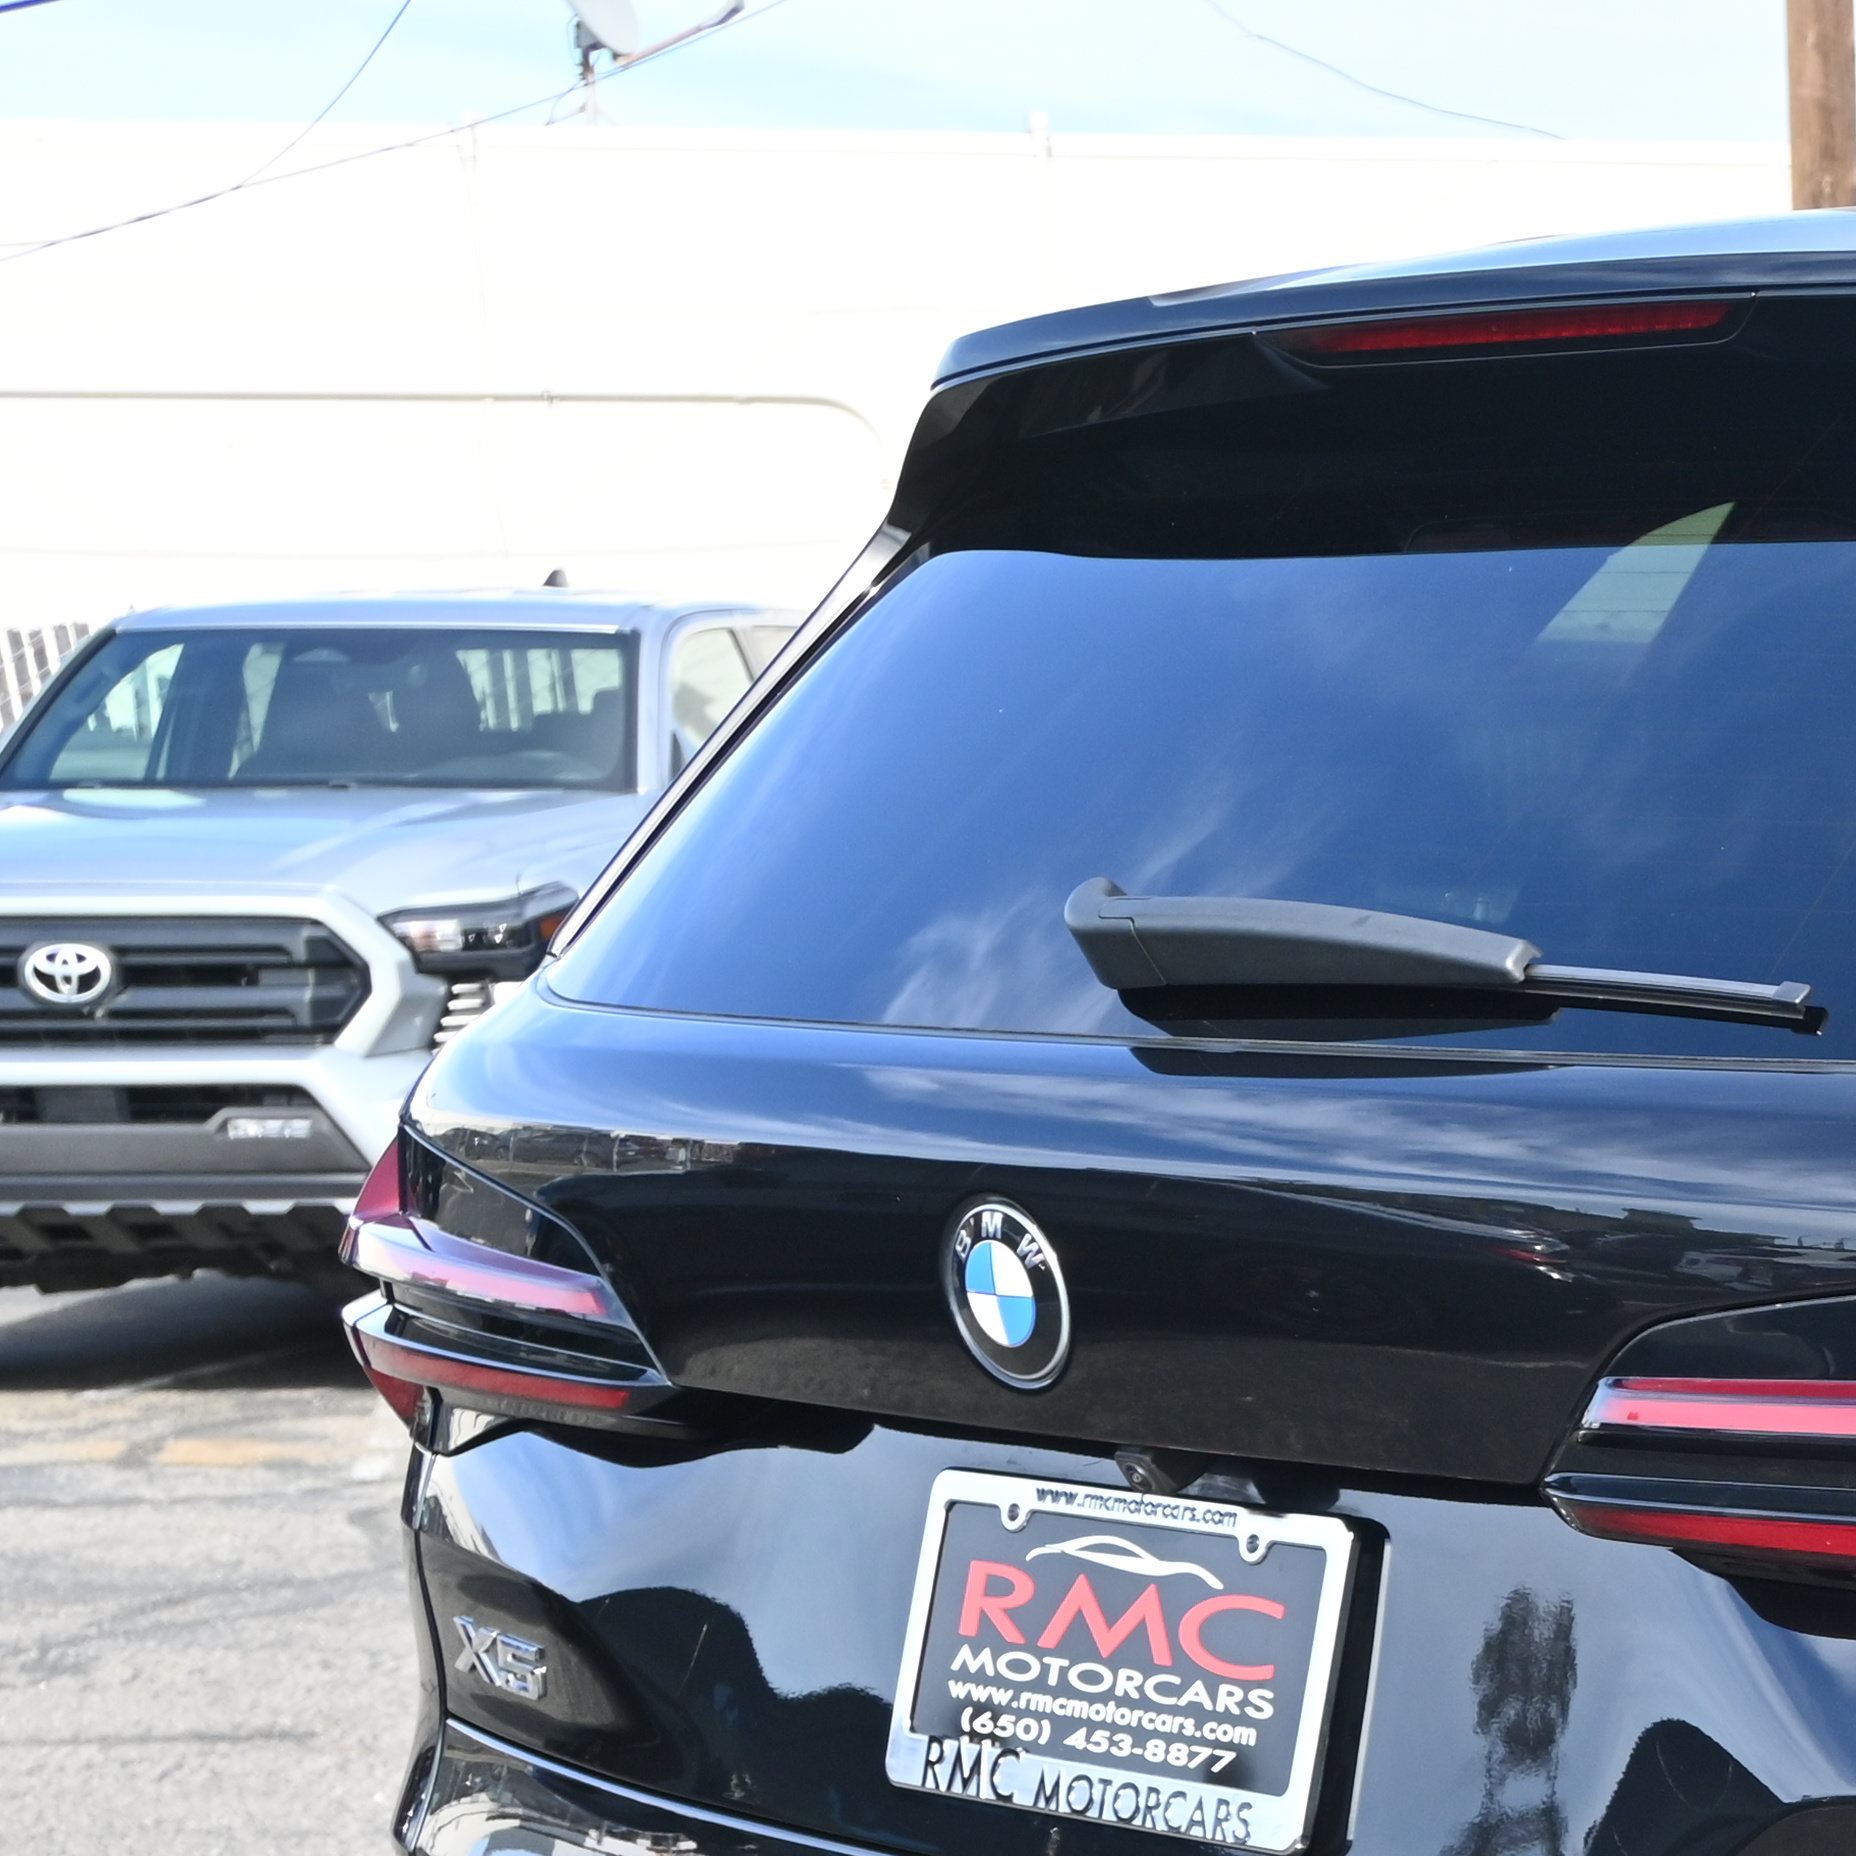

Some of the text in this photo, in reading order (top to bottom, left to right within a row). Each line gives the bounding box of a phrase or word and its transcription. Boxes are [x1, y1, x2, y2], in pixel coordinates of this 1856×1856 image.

[955, 1211, 1046, 1270] BMW
[1036, 1487, 1238, 1528] www.rmcmotorcars.com
[957, 1559, 1286, 1681] RMC
[453, 1615, 547, 1700] X5
[949, 1644, 1275, 1720] MOTORCARS
[947, 1679, 1257, 1746] www.rmcmotorcars.com
[960, 1706, 1237, 1773] (650) 453-8877
[921, 1736, 1254, 1845] RMC MOTORCARS
